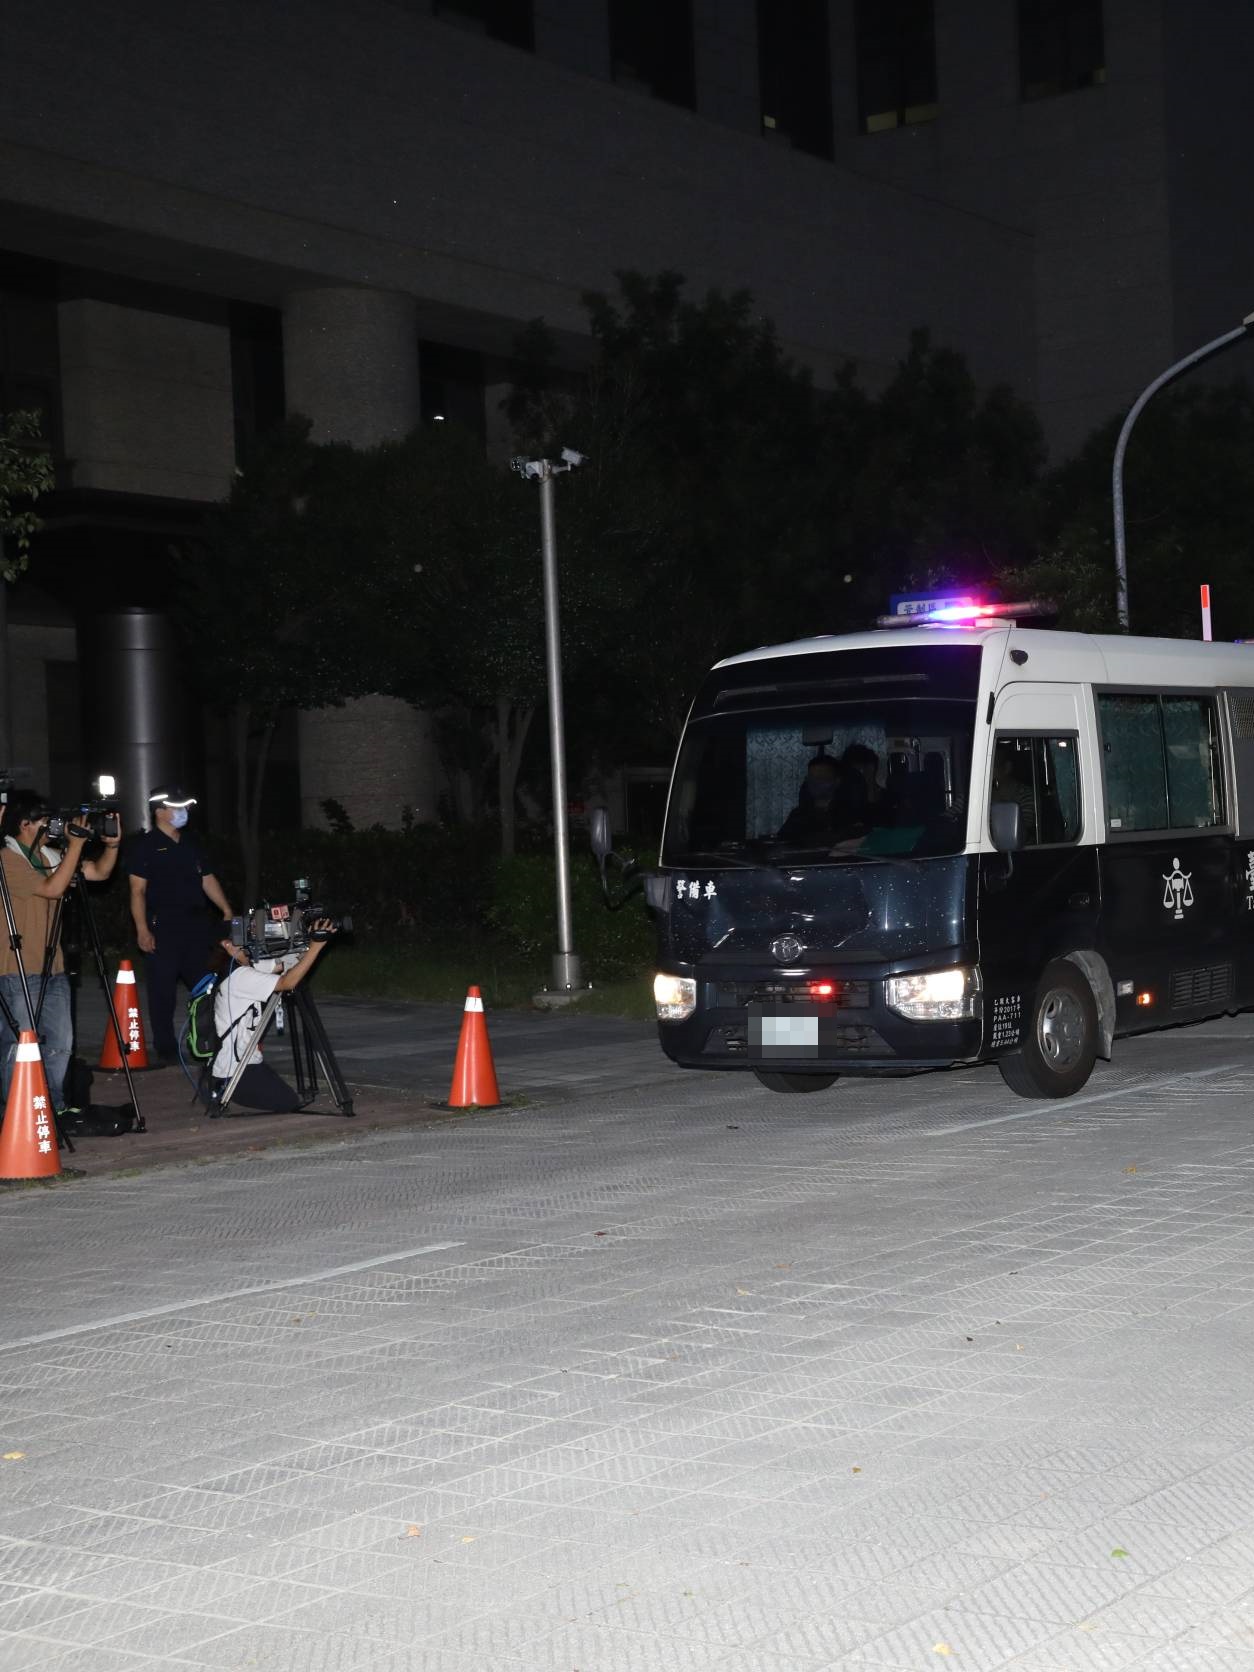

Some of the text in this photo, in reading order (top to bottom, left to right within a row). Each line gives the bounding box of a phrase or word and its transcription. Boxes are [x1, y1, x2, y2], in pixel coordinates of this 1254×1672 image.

[128, 1007, 141, 1052] 禁止停車
[993, 1011, 1021, 1023] PAA-711
[33, 1095, 51, 1154] 禁止停車
